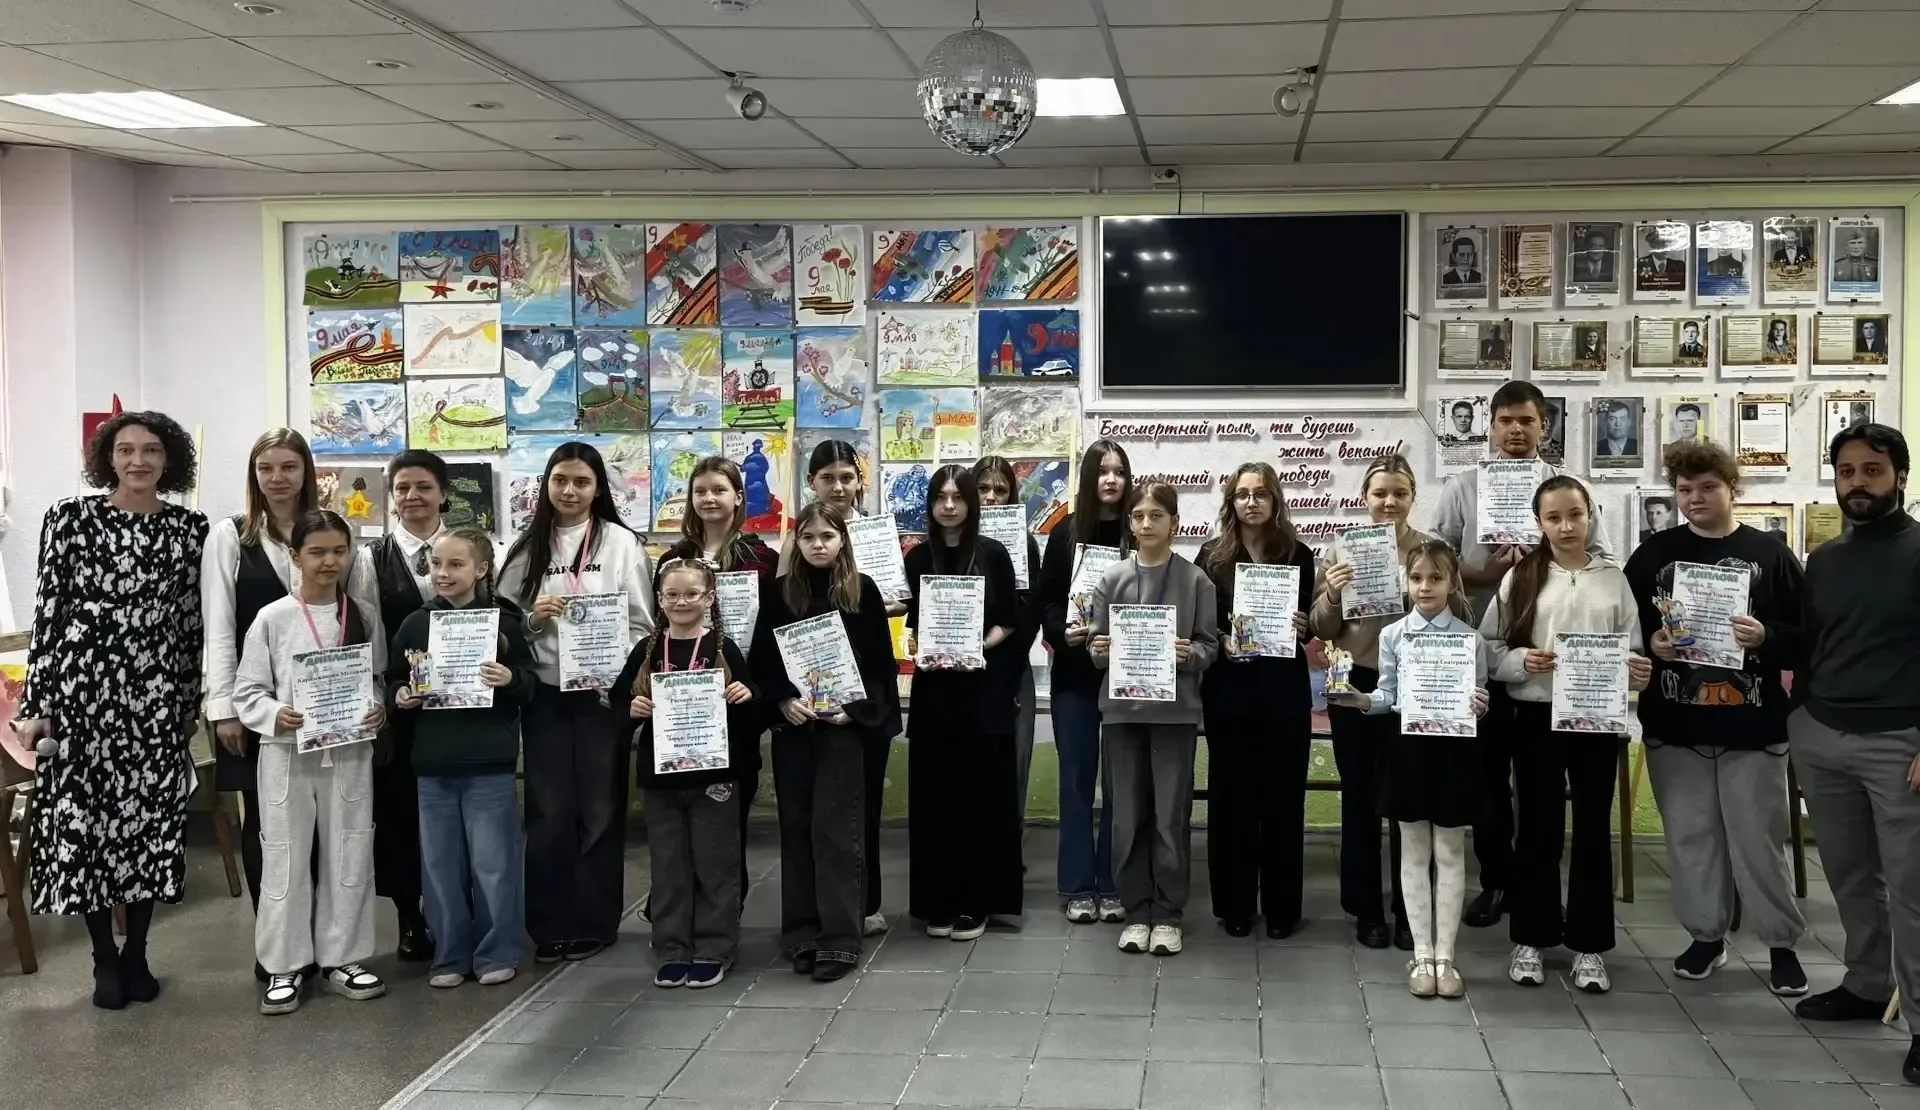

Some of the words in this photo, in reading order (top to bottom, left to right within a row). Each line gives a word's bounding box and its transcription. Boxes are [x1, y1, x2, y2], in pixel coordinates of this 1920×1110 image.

[808, 266, 820, 288] 9
[316, 330, 330, 351] 9
[1100, 420, 1209, 440] Бессмертный
[1216, 422, 1255, 436] полк,
[1269, 422, 1293, 434] ты
[1301, 416, 1355, 439] будешь
[1278, 446, 1325, 459] жить
[1279, 464, 1331, 487] победы
[1288, 493, 1332, 508] ашей
[1246, 569, 1290, 580] ДИПЛОМ
[717, 577, 748, 586] ПЛОМ
[931, 581, 975, 590] ДИПЛОМ
[441, 615, 489, 626] ДИПЛОМ
[1119, 610, 1167, 620] ДИПЛОМ
[1413, 639, 1465, 649] ДИПЛОМ
[1566, 639, 1619, 649] ДИПЛОМ
[305, 650, 361, 667] ДИПЛОМ
[663, 674, 714, 689] ДИПЛОМ
